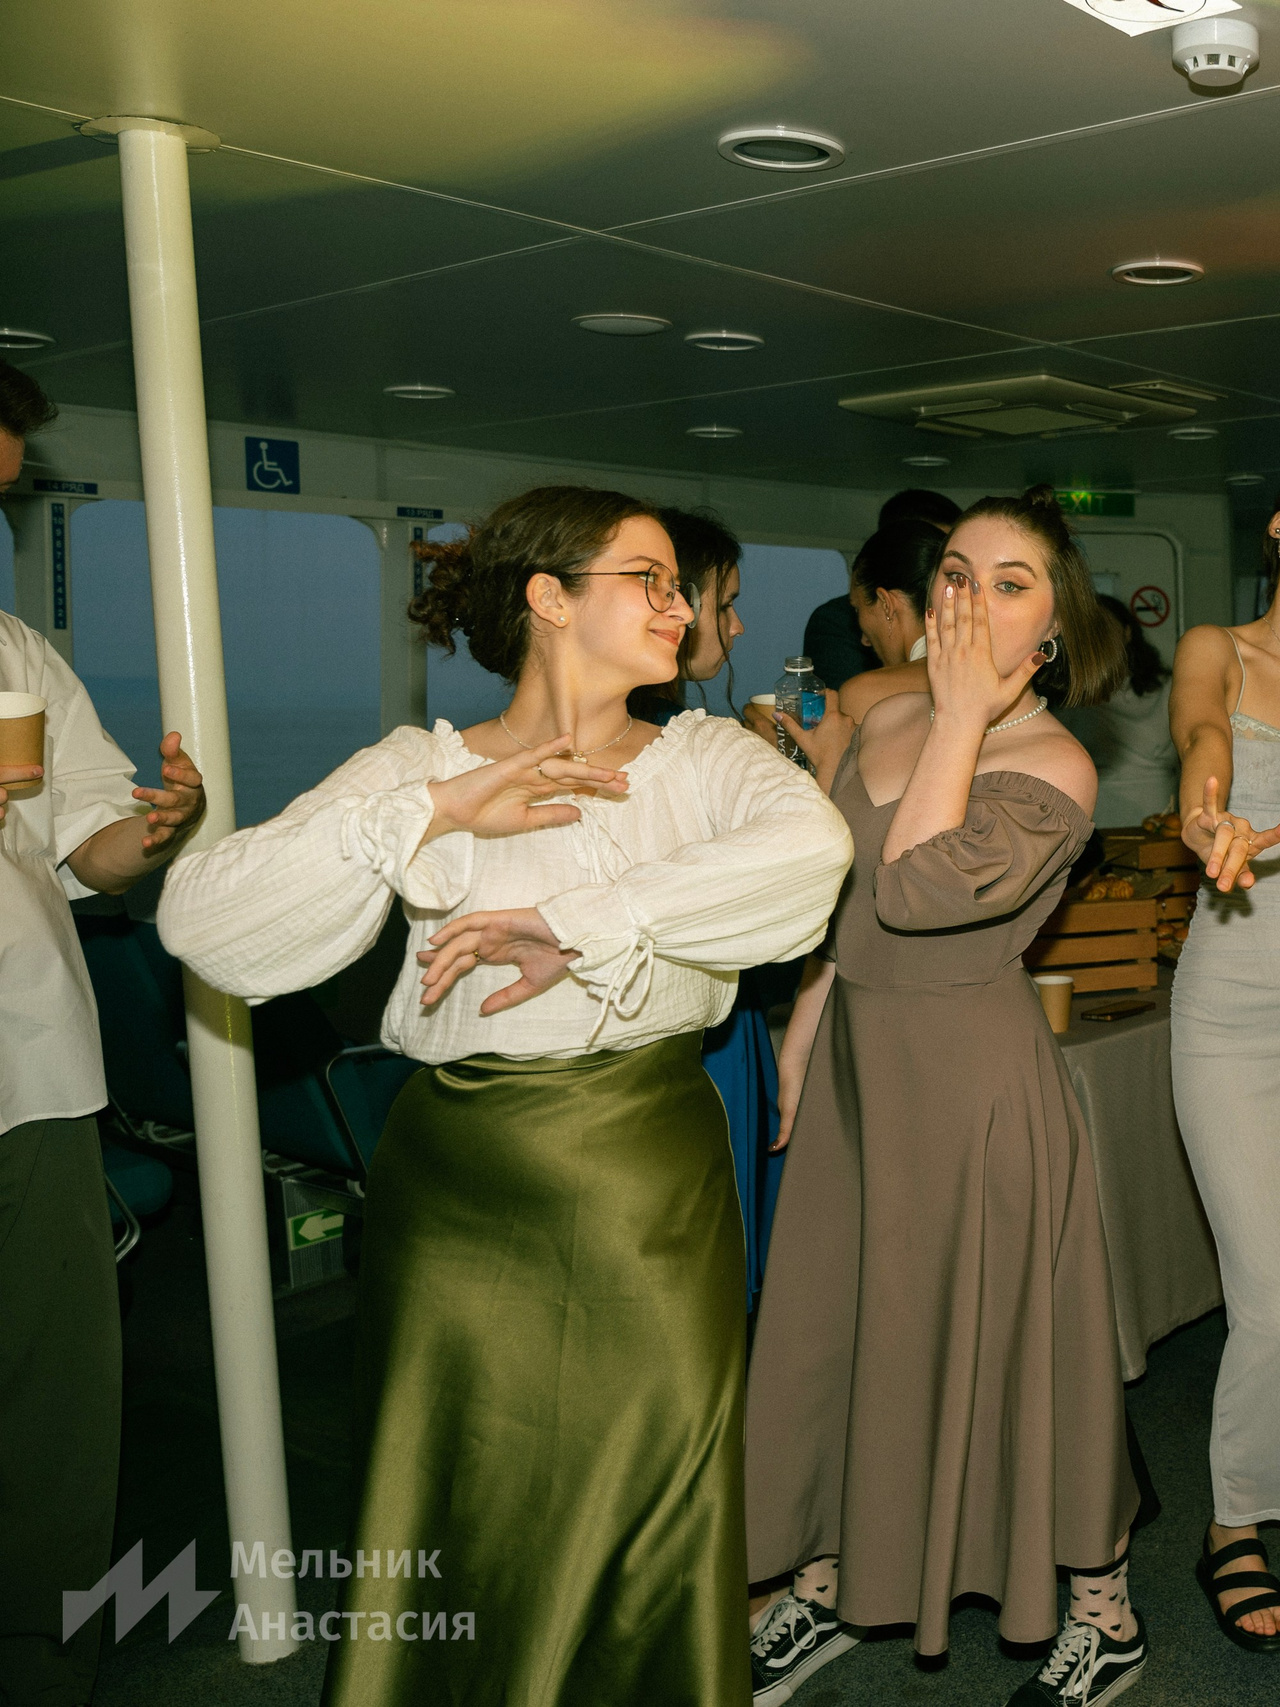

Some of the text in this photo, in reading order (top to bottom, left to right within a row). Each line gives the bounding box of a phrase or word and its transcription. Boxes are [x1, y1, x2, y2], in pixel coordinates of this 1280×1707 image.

[62, 483, 86, 494] РЯД
[1055, 492, 1106, 513] EXIT
[53, 517, 63, 525] 10
[776, 701, 787, 757] BAIKL
